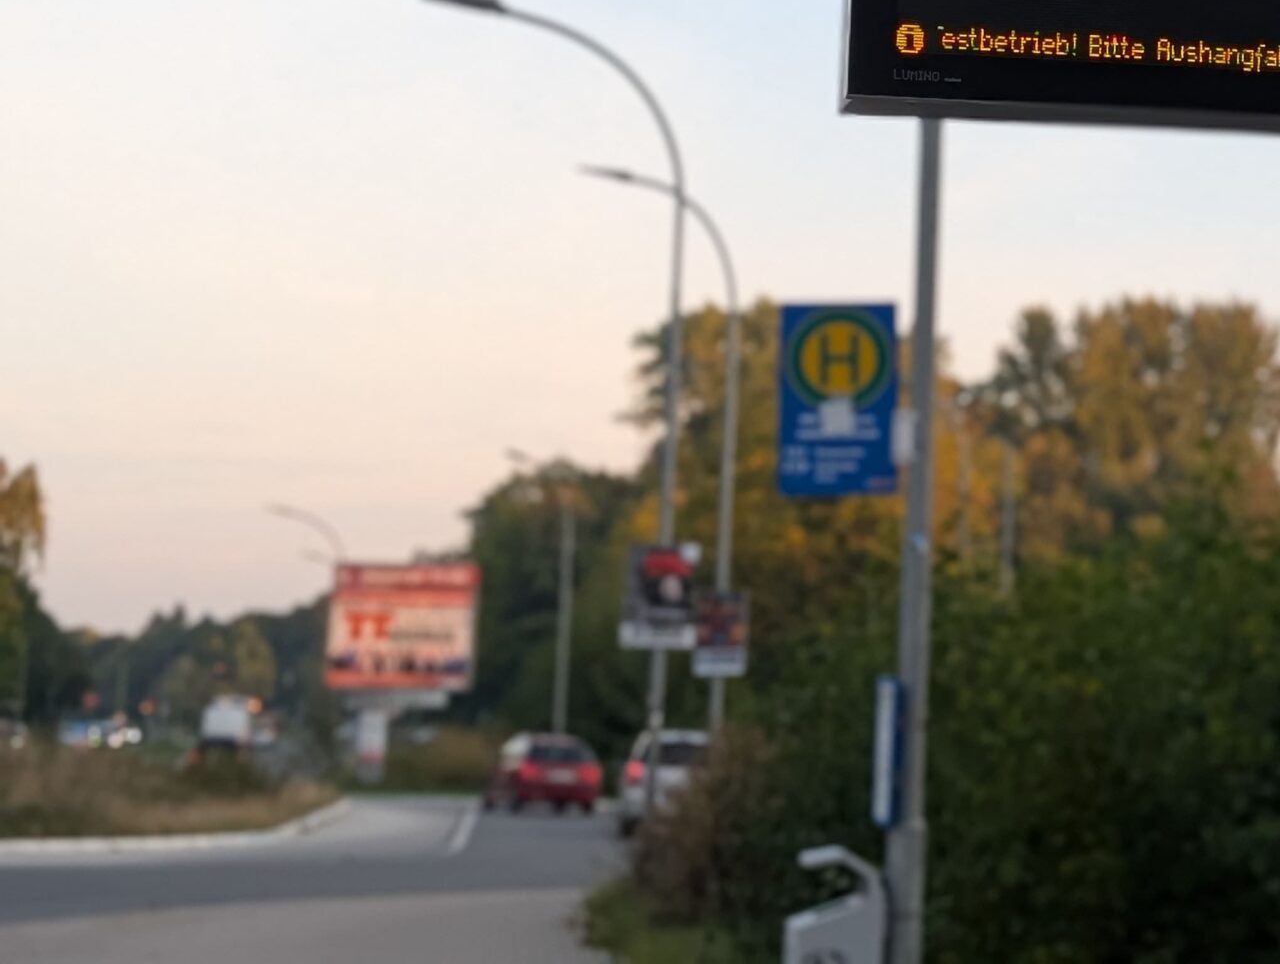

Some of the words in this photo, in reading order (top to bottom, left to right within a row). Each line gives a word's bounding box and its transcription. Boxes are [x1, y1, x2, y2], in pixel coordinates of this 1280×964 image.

[936, 25, 1078, 57] estbetrieb!
[1088, 34, 1145, 60] Bitte
[893, 68, 941, 82] LUMINO
